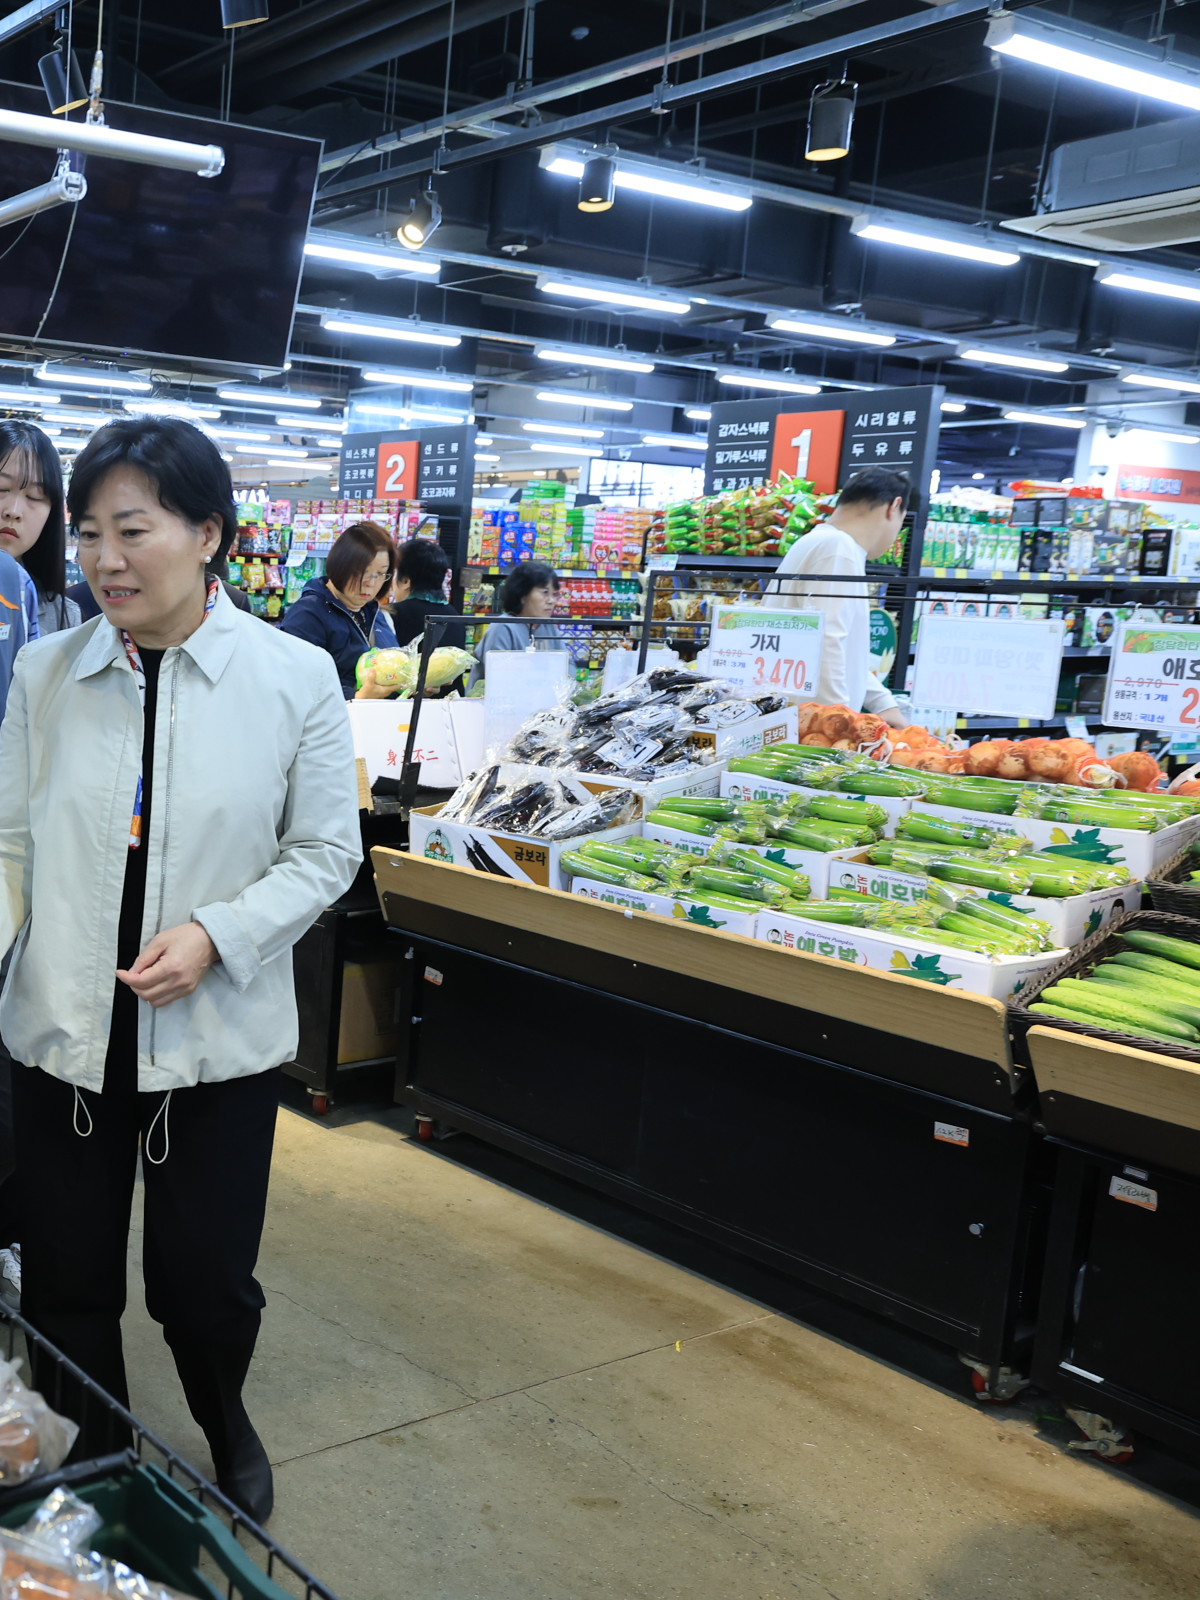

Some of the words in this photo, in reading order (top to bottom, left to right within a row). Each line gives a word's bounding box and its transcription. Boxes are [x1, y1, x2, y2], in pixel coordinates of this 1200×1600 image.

[854, 410, 917, 428] 시리얼류
[718, 421, 770, 438] 감자스낵류
[715, 449, 768, 465] 밀가루스낵류
[790, 428, 813, 479] 1
[384, 453, 406, 492] 2
[750, 633, 781, 653] 가지
[753, 656, 807, 690] 3470
[804, 681, 813, 692] 원
[763, 725, 787, 745] 금보라
[514, 845, 548, 867] 금보라
